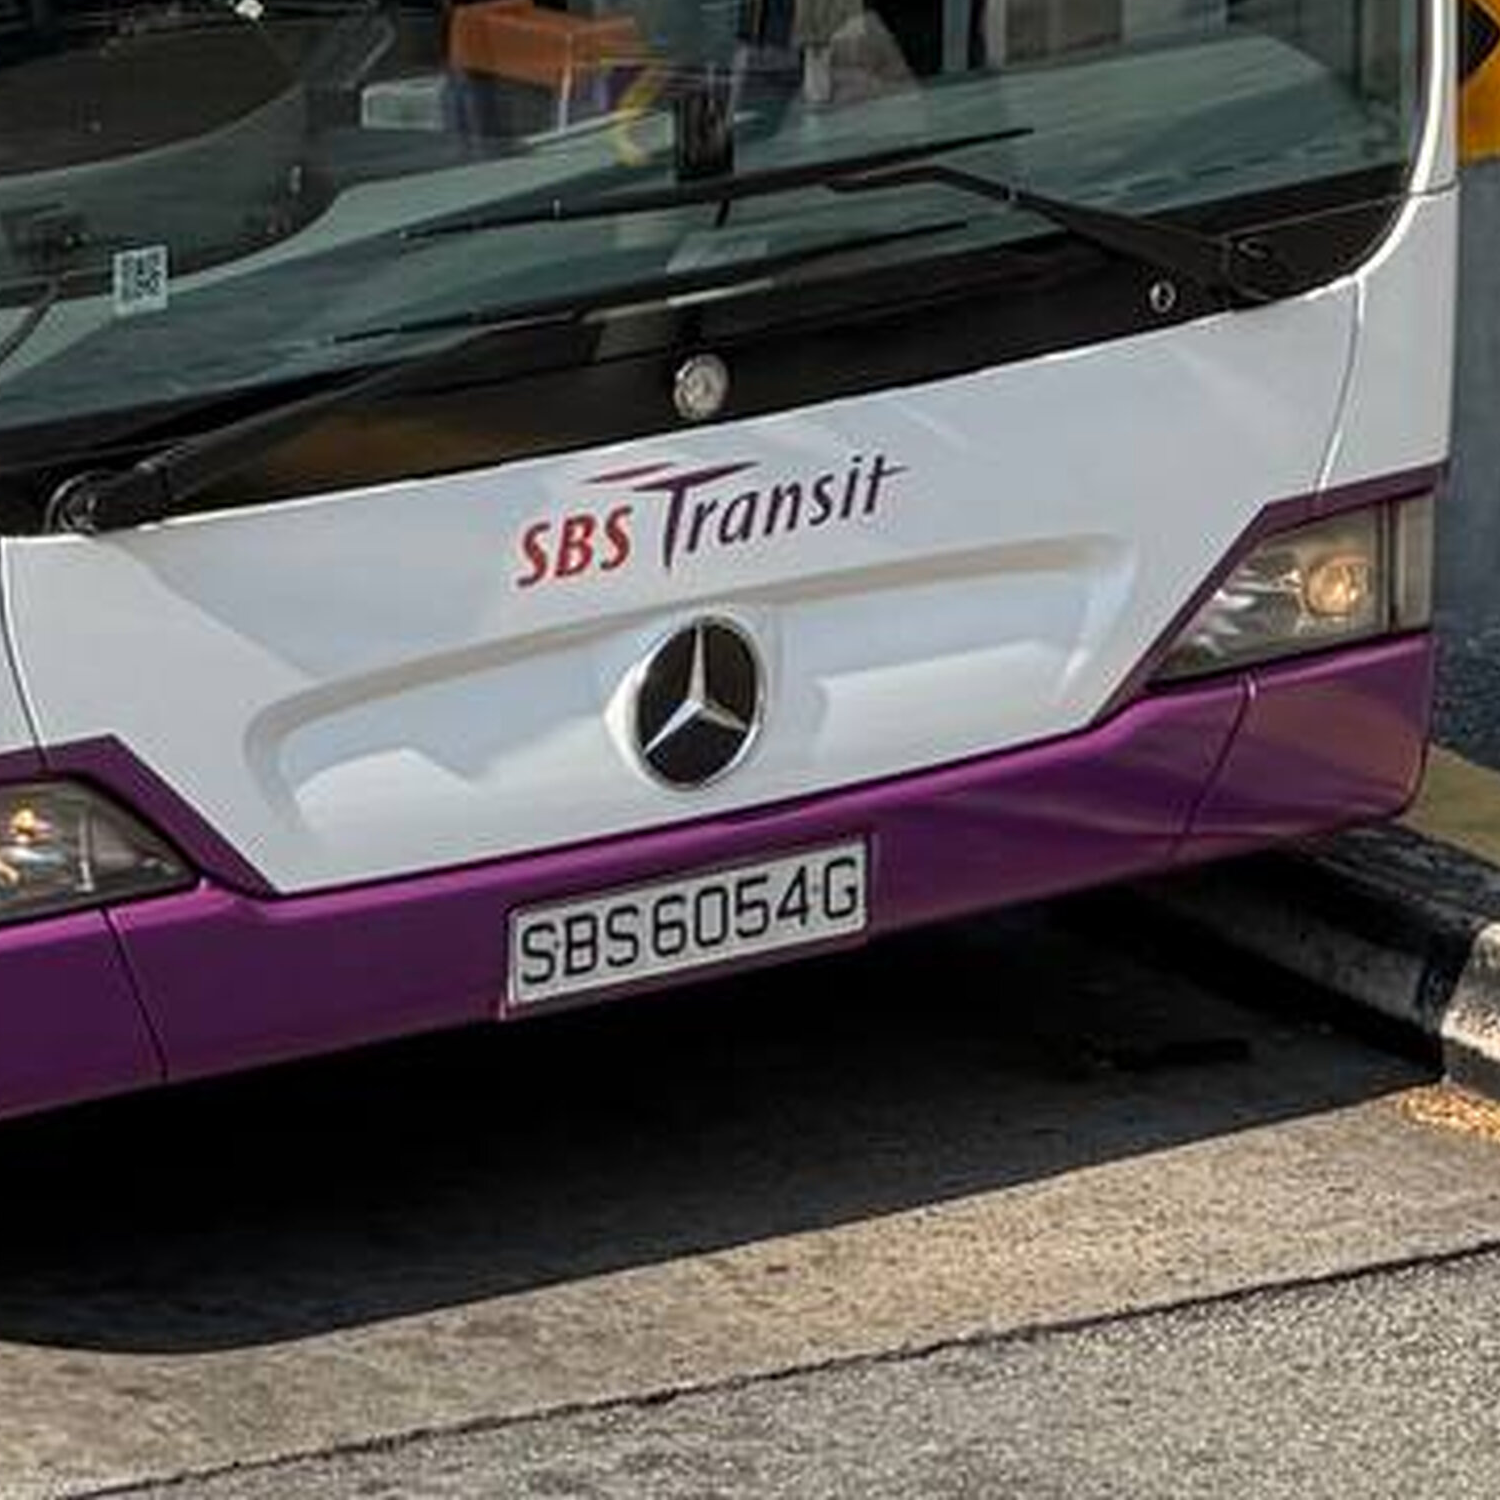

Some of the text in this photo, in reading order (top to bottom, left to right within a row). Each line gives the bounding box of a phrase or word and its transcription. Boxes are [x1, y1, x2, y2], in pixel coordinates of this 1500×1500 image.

[516, 454, 910, 588] SBS Transit
[520, 856, 858, 985] SBS6054G
